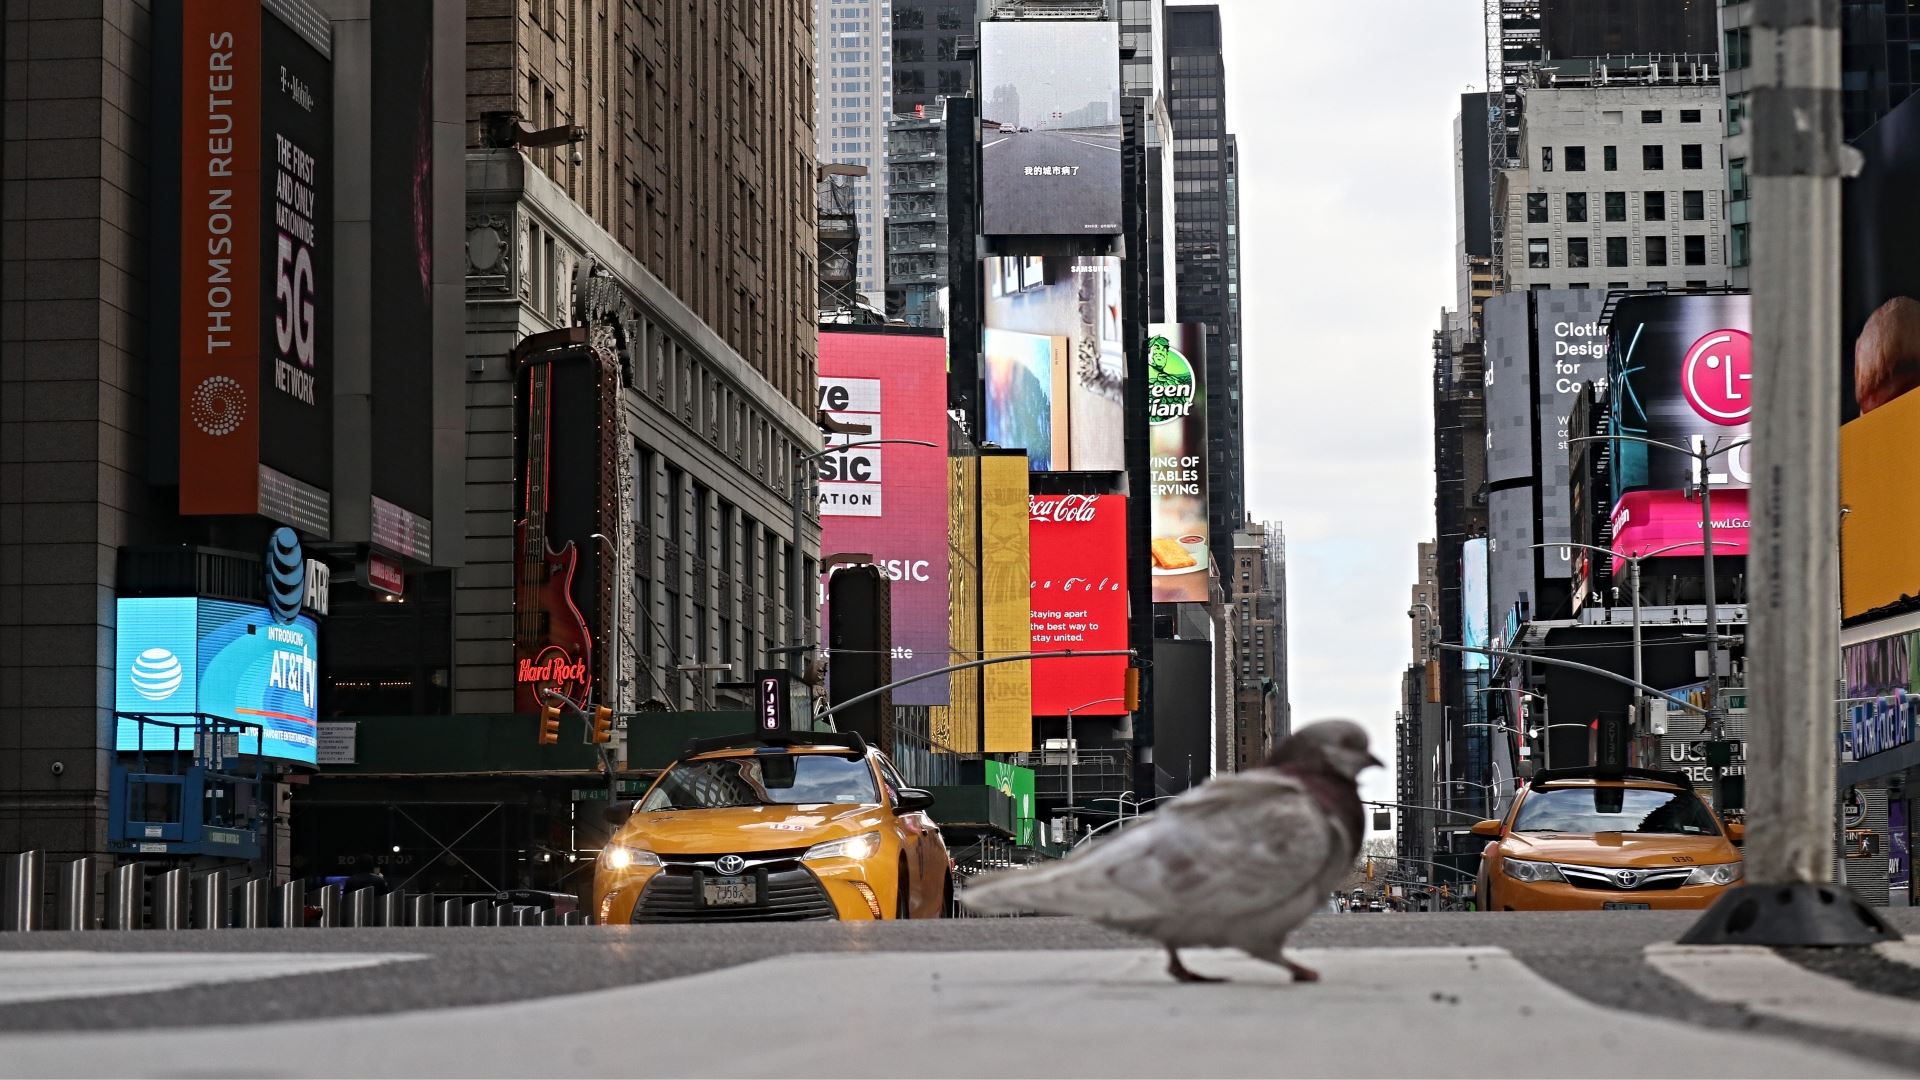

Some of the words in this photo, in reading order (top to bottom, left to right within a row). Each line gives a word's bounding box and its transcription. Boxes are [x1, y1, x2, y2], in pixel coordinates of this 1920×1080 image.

[208, 31, 233, 177] REUTERS
[276, 133, 292, 170] THE
[293, 145, 315, 185] FIRST
[1024, 166, 1079, 176] 我的城市病了
[276, 169, 293, 204] AND
[294, 181, 315, 219] ONLY
[276, 201, 315, 247] NATIONWIDE
[208, 189, 231, 354] THOMSON
[275, 232, 315, 368] 5G
[1555, 360, 1580, 374] for
[275, 358, 315, 406] NETWORK
[1149, 399, 1193, 416] iant
[1180, 456, 1199, 468] OF
[305, 559, 330, 614] AT&
[1029, 610, 1062, 619] Staying
[1064, 610, 1088, 619] apart
[1030, 622, 1044, 630] the
[1047, 622, 1067, 630] best
[1069, 623, 1086, 632] way
[268, 626, 304, 646] INTRODUCING
[1032, 634, 1051, 642] stay
[1054, 633, 1084, 642] united.
[518, 658, 552, 682] Hard
[553, 657, 586, 685] Rock
[765, 681, 776, 728] 7J58
[580, 790, 587, 799] W
[590, 790, 598, 799] 43
